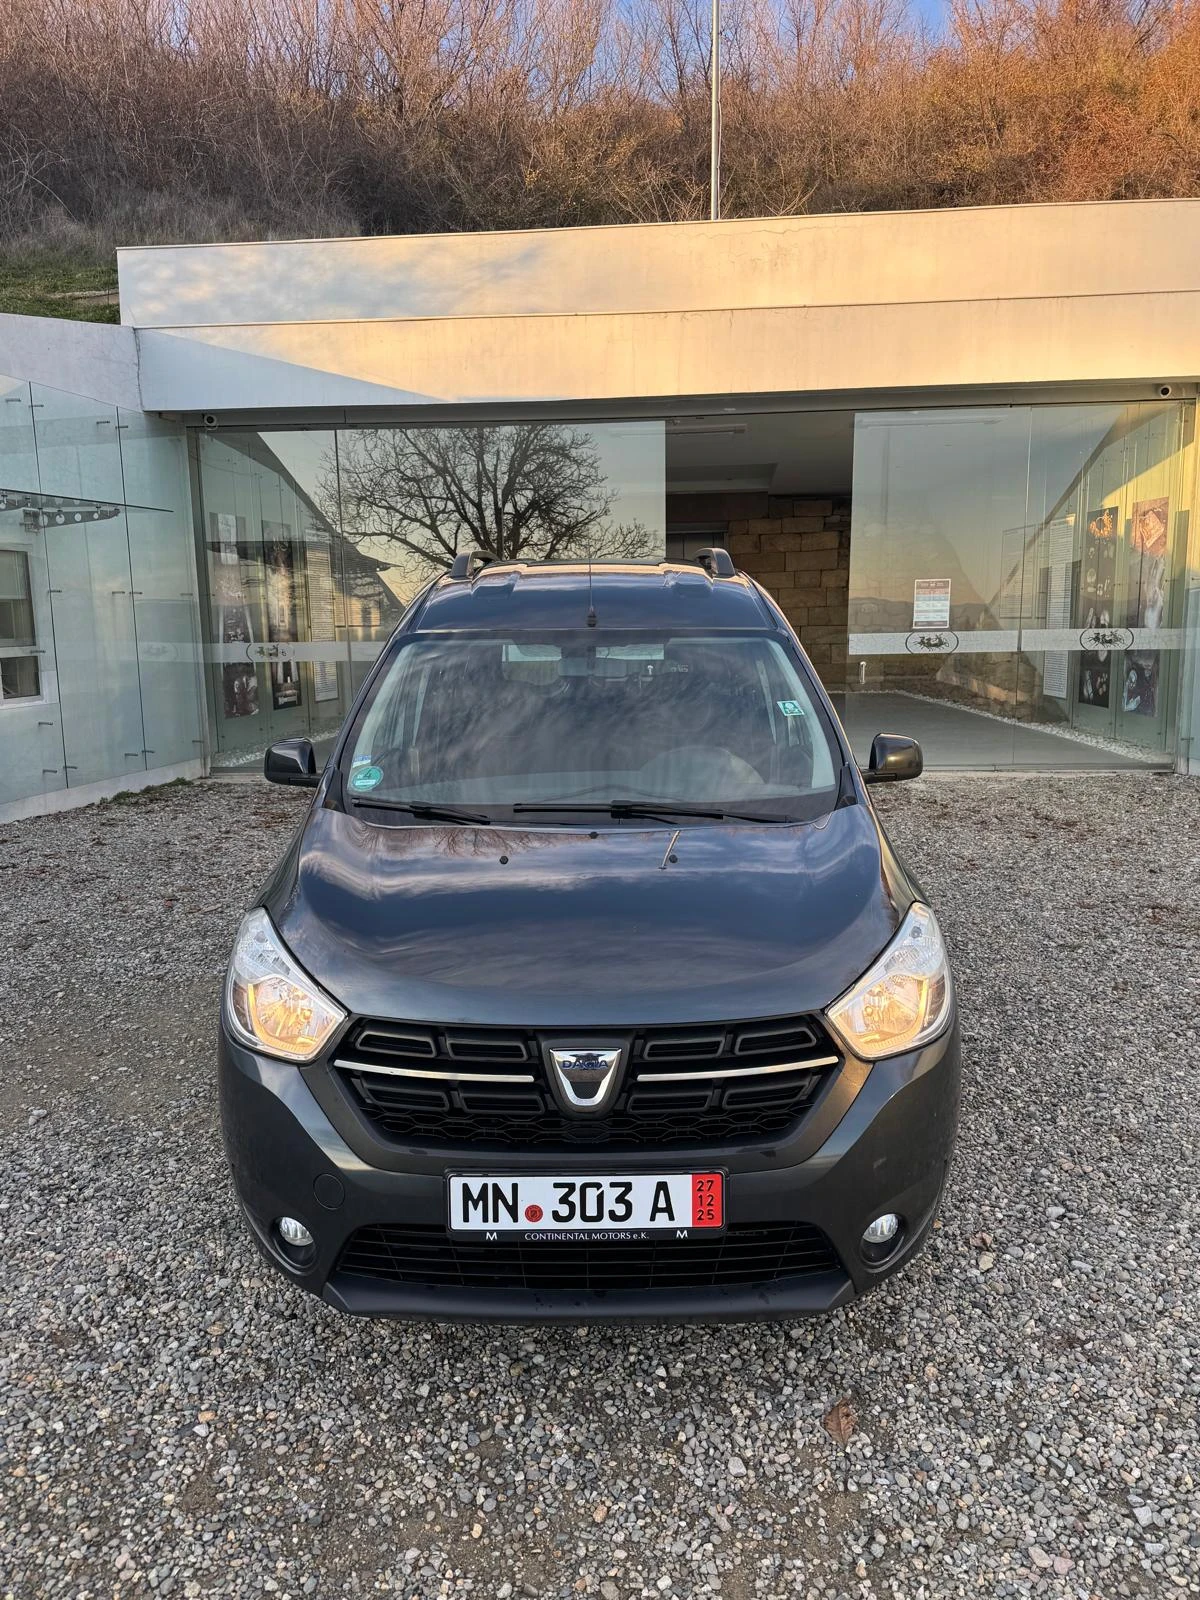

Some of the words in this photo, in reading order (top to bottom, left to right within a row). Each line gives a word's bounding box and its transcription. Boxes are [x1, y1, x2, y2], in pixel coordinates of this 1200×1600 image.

[562, 1060, 609, 1069] DACIA
[696, 1179, 714, 1192] 27
[462, 1182, 518, 1223] MN
[551, 1181, 633, 1223] 303
[649, 1180, 675, 1222] A
[698, 1194, 715, 1207] 12
[697, 1209, 715, 1220] 25
[524, 1231, 589, 1241] CONTINENTAL
[591, 1231, 631, 1240] MOTORS
[632, 1231, 650, 1239] e.K.
